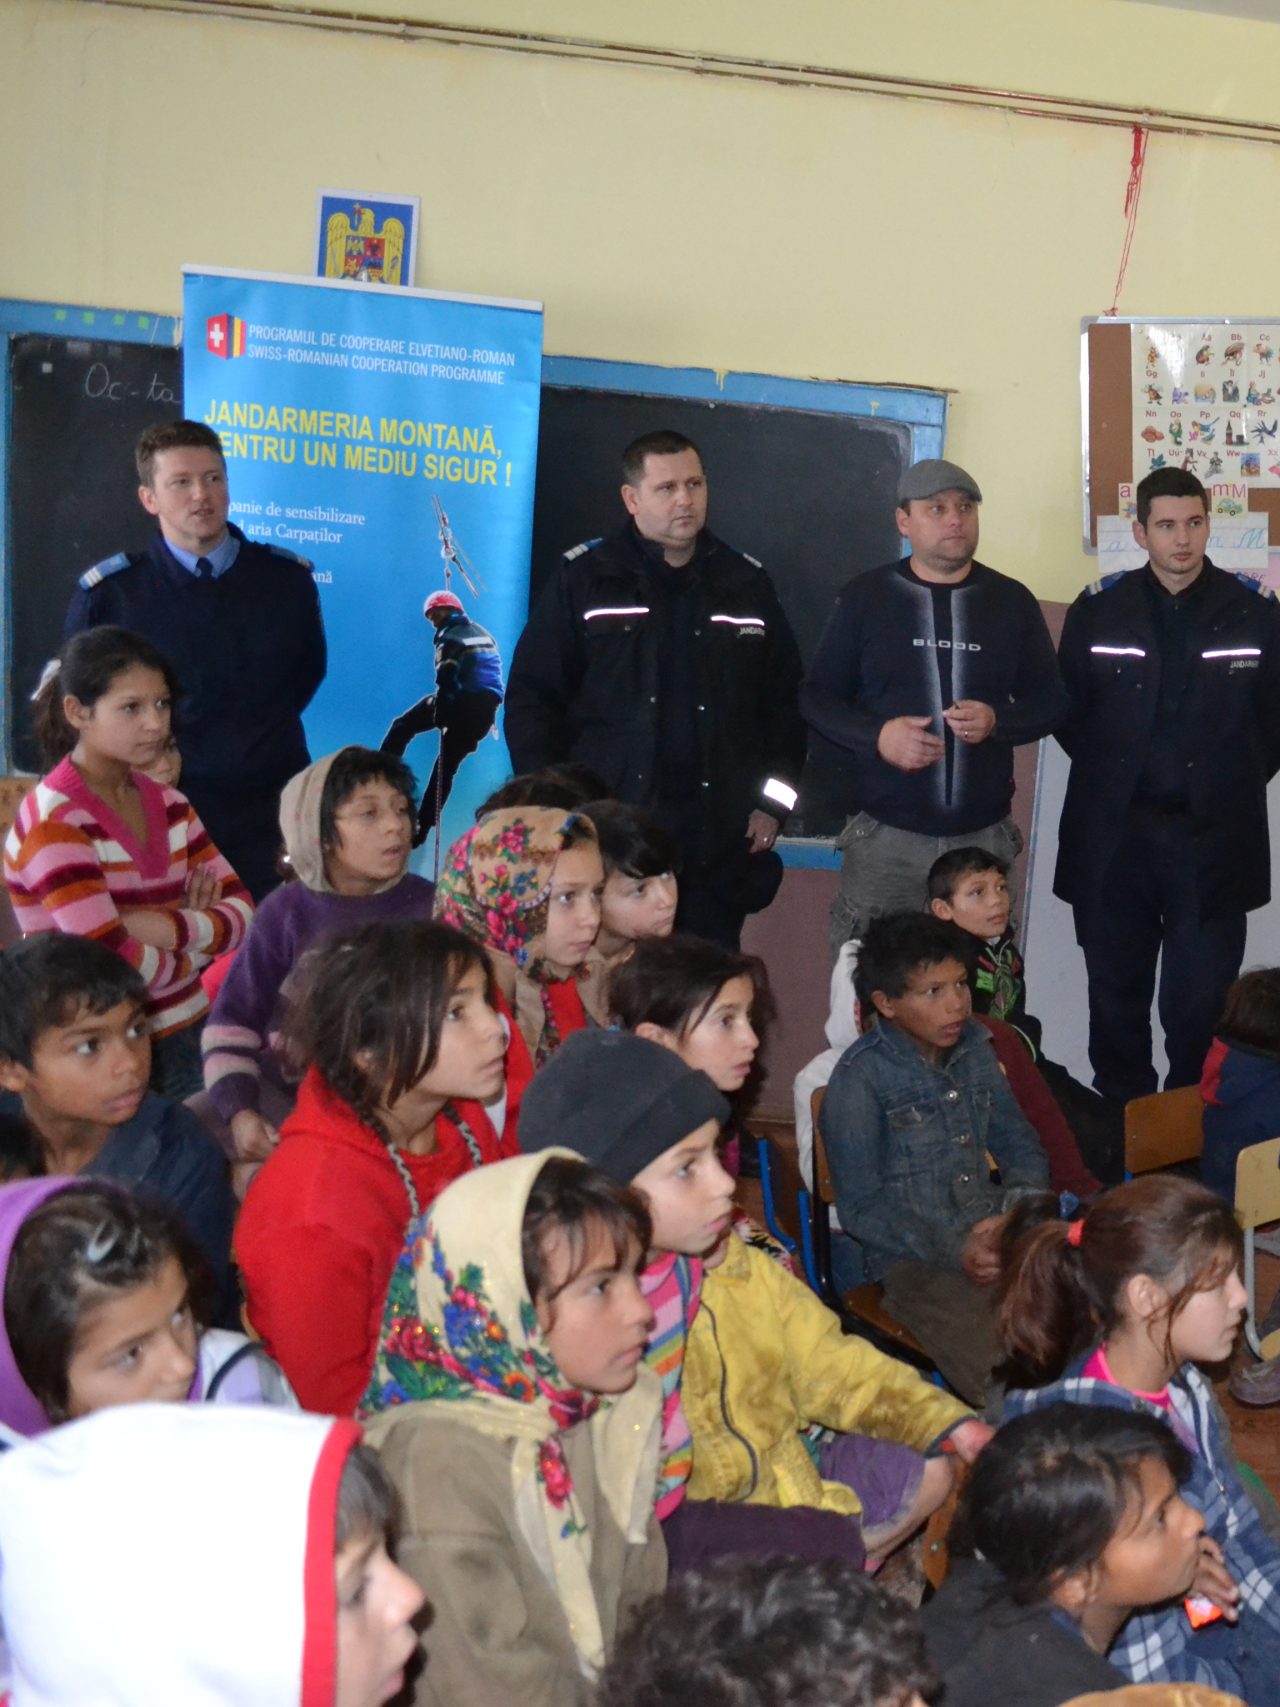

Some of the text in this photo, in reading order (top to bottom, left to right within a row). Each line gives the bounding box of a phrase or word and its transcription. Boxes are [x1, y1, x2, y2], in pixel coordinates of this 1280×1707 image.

[1231, 333, 1242, 341] Bb
[1259, 333, 1271, 341] Cc
[249, 325, 515, 367] PROGRAMUL DE COOPERARE ELVETIANO-ROMAN
[248, 344, 505, 385] SWISS-ROMANIAN COOPERATION PROGRAMME
[1146, 369, 1158, 378] Gg
[1258, 370, 1266, 379] Jj
[1145, 410, 1157, 418] Nn
[1170, 410, 1182, 418] Oo
[1200, 410, 1211, 419] Pp
[1229, 410, 1241, 418] Qq
[204, 399, 503, 460] JANDARMERIA MONTANĂ,
[218, 431, 296, 464] ENTRU
[303, 440, 337, 468] UN
[344, 443, 417, 477] MEDIU
[423, 453, 498, 486] SIGUR
[1196, 449, 1207, 457] Vv
[1226, 449, 1241, 457] Ww
[1267, 448, 1279, 456] Xx
[228, 500, 366, 526] panie de sensibilizare
[247, 522, 272, 537] aria
[912, 638, 982, 651] BLOOD
